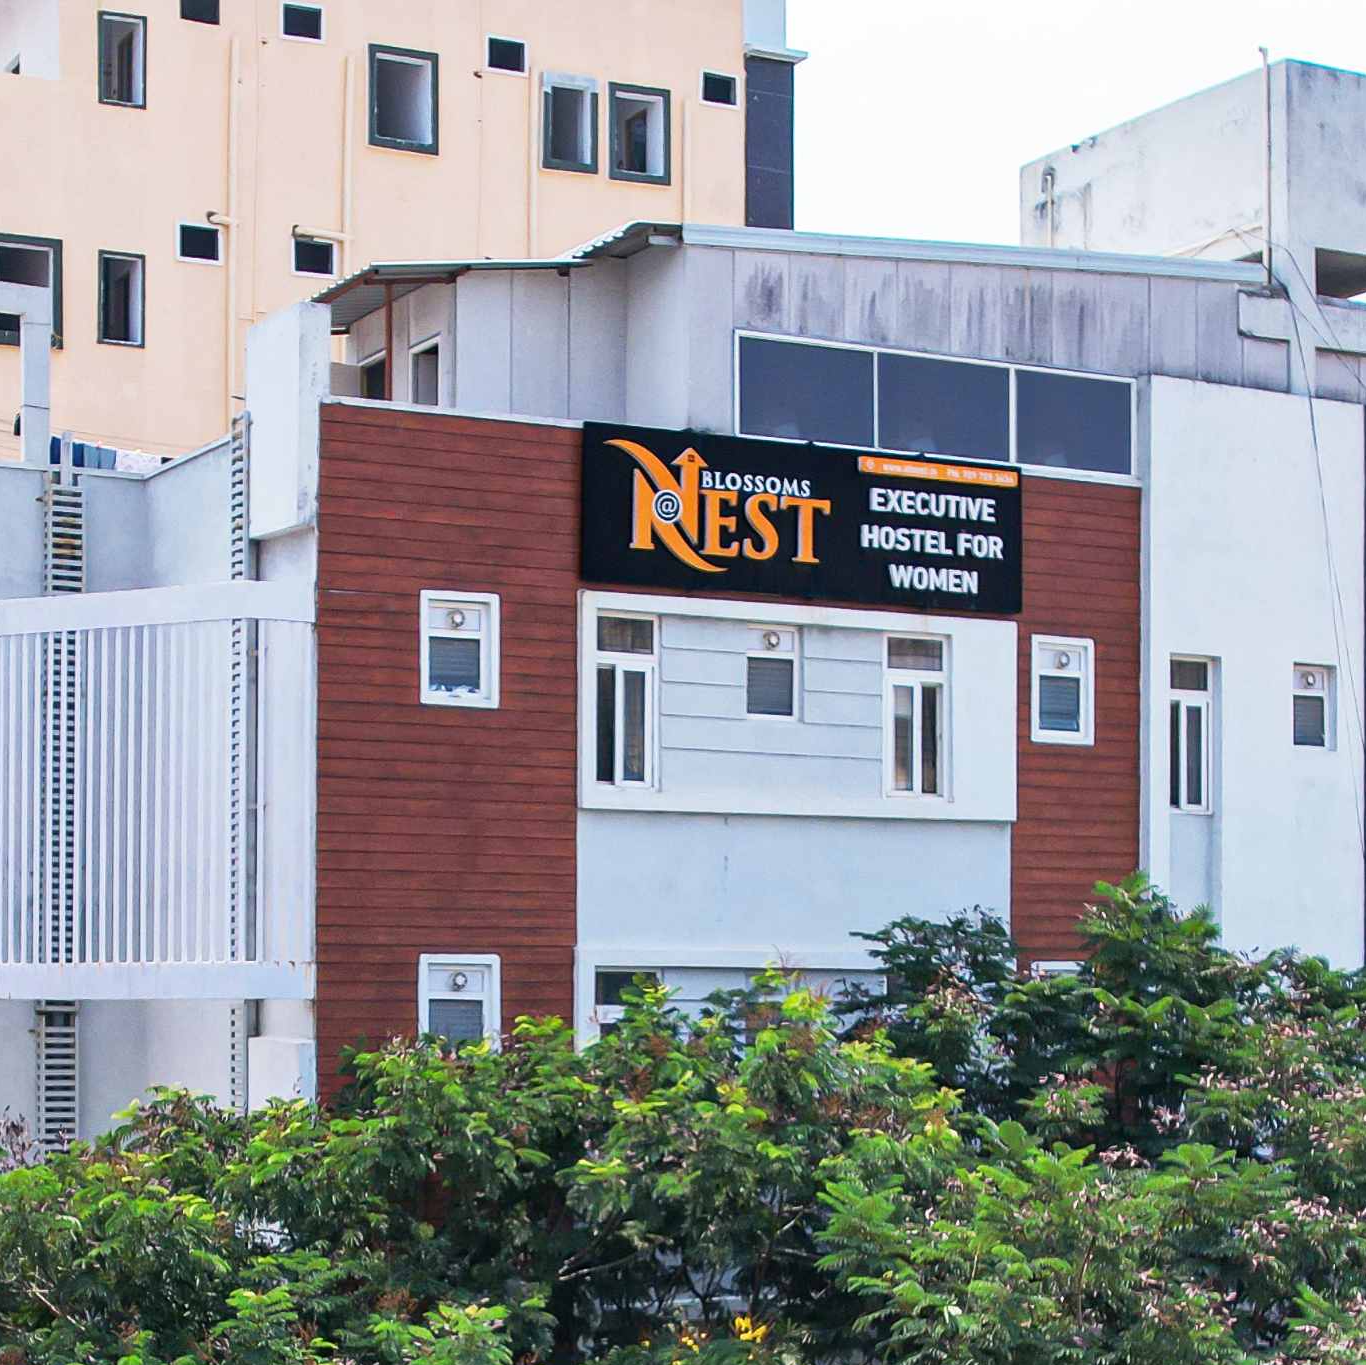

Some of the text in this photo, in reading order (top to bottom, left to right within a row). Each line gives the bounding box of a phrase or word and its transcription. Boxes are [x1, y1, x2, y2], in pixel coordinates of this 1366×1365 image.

[701, 470, 811, 497] BLOSSOMS
[603, 439, 832, 573] NEST
[869, 487, 996, 523] EXECUTIVE
[860, 524, 1004, 560] HOSTEL FOR
[888, 563, 979, 594] WOMEN
